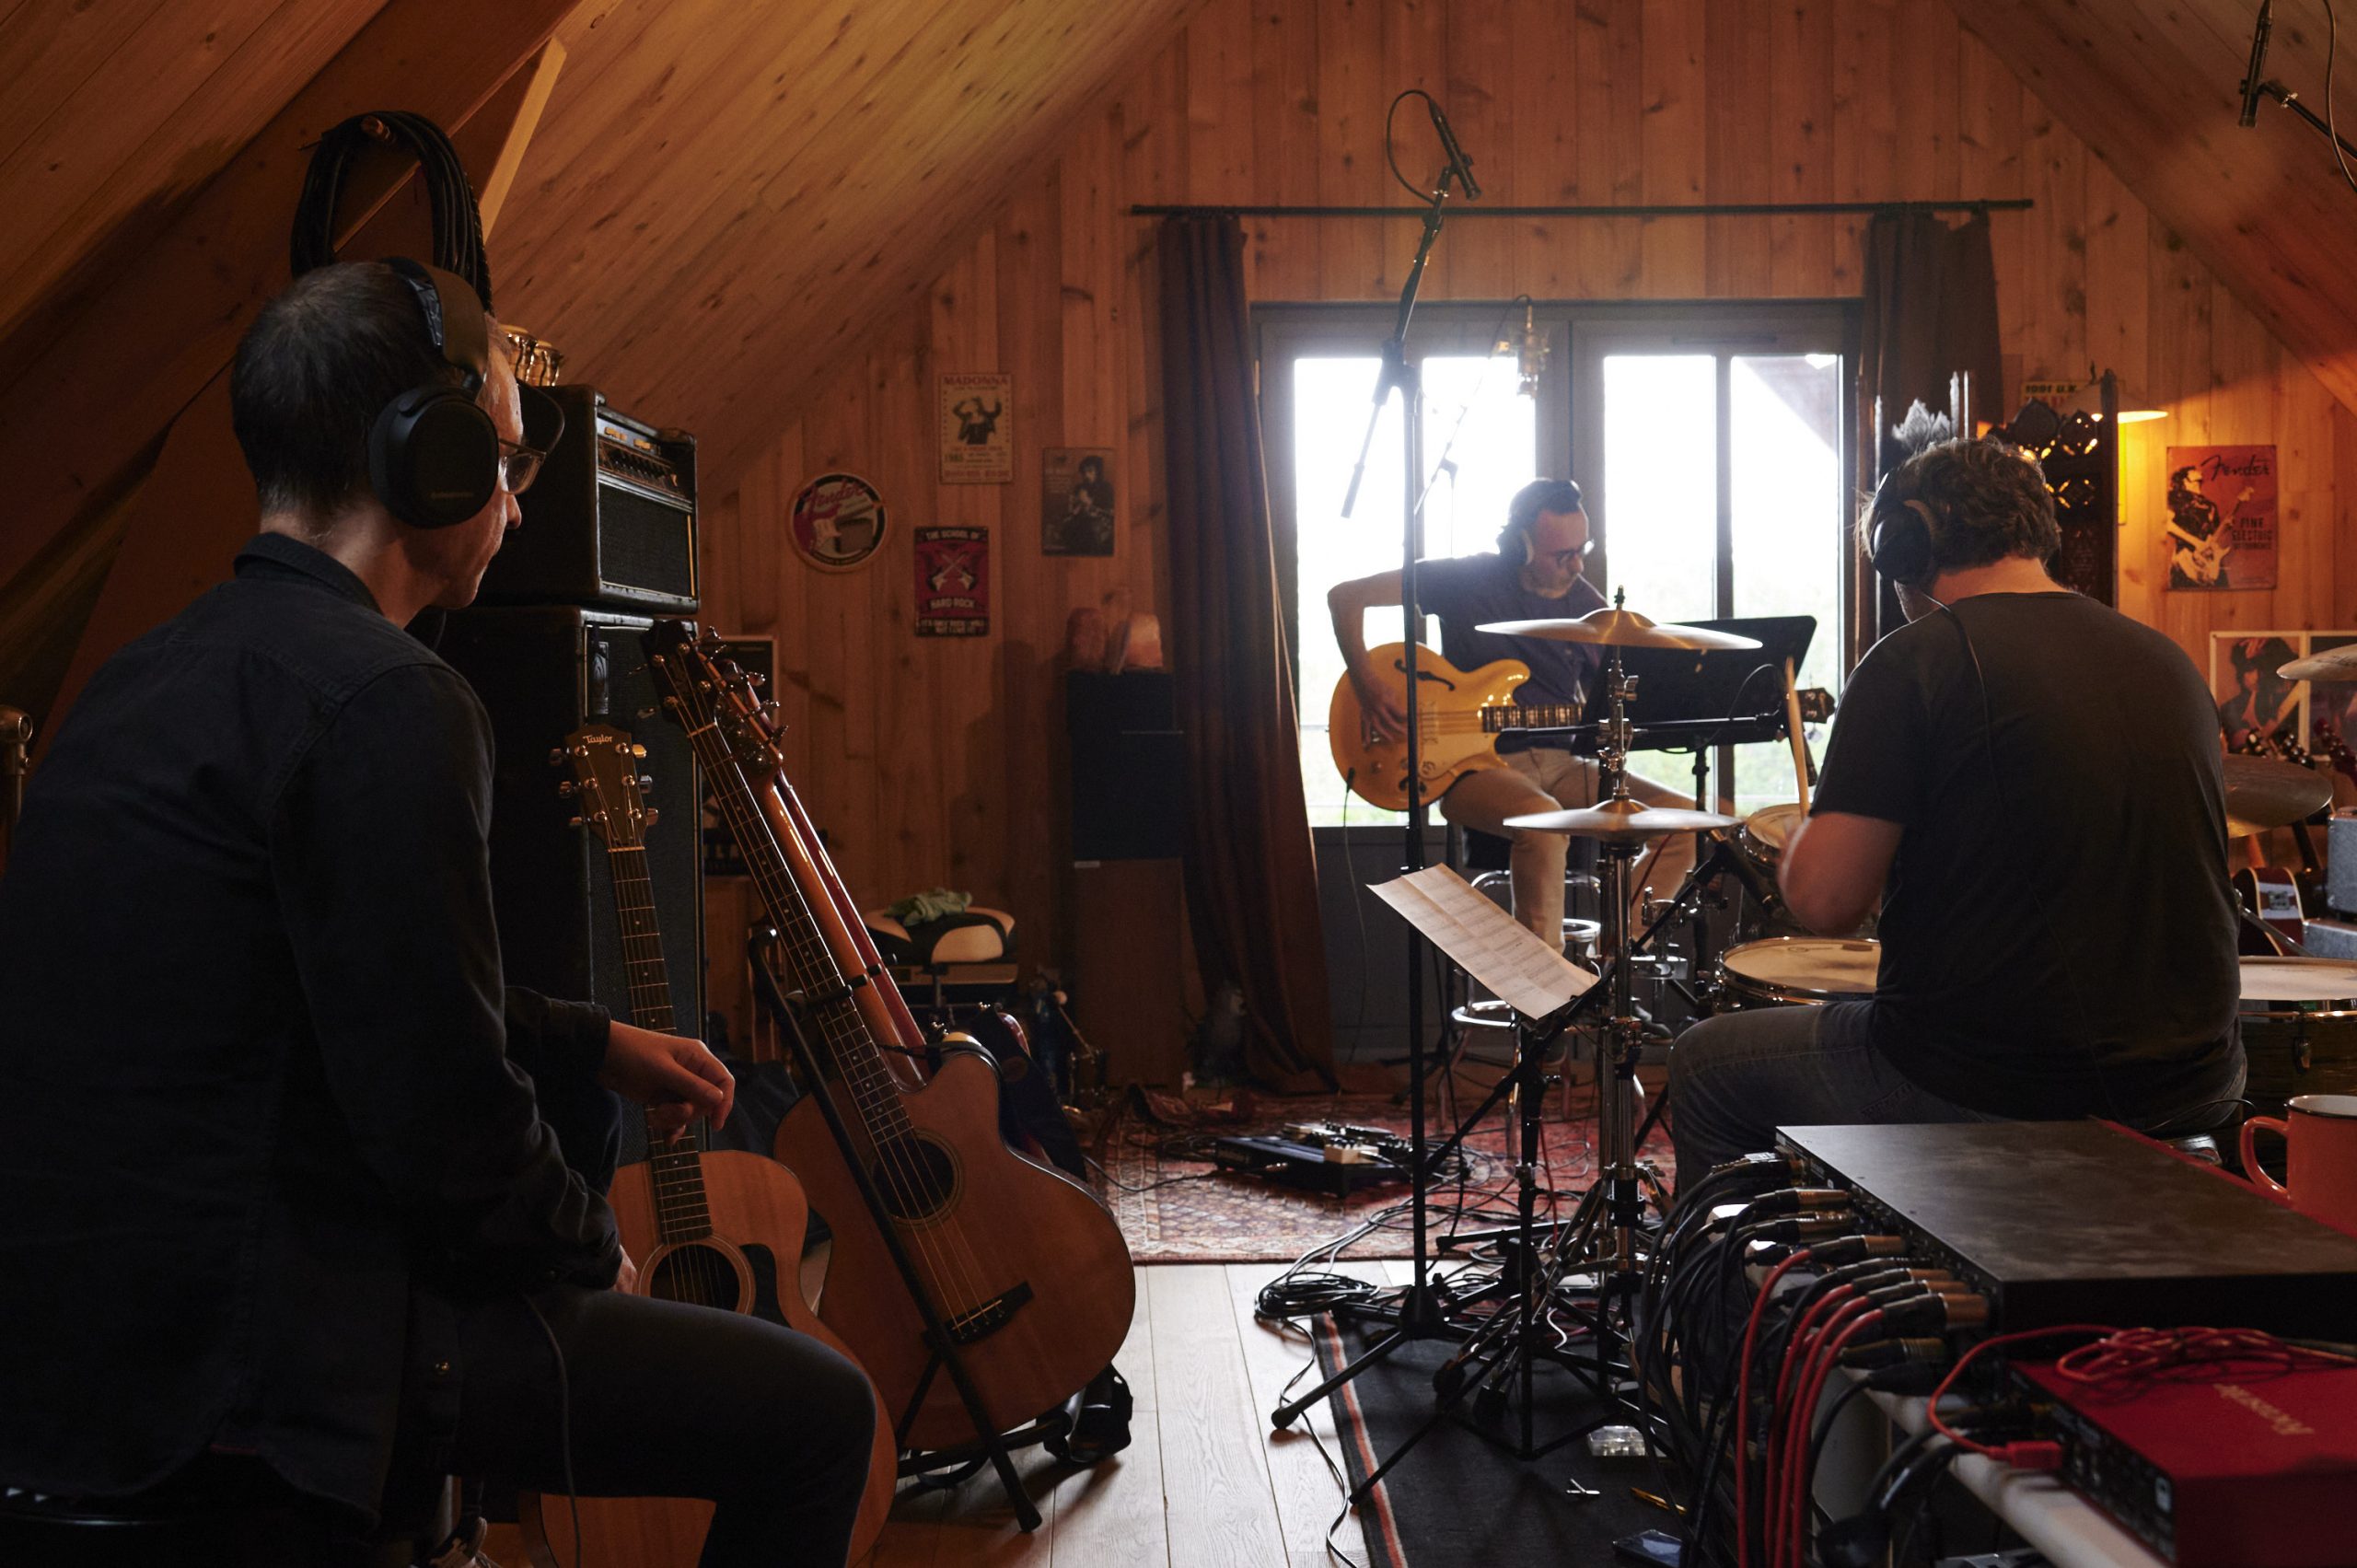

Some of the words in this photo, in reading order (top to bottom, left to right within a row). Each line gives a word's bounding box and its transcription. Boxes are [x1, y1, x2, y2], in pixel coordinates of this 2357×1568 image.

[2200, 454, 2270, 482] Fender
[797, 477, 869, 511] Fender
[583, 733, 613, 745] Taylor
